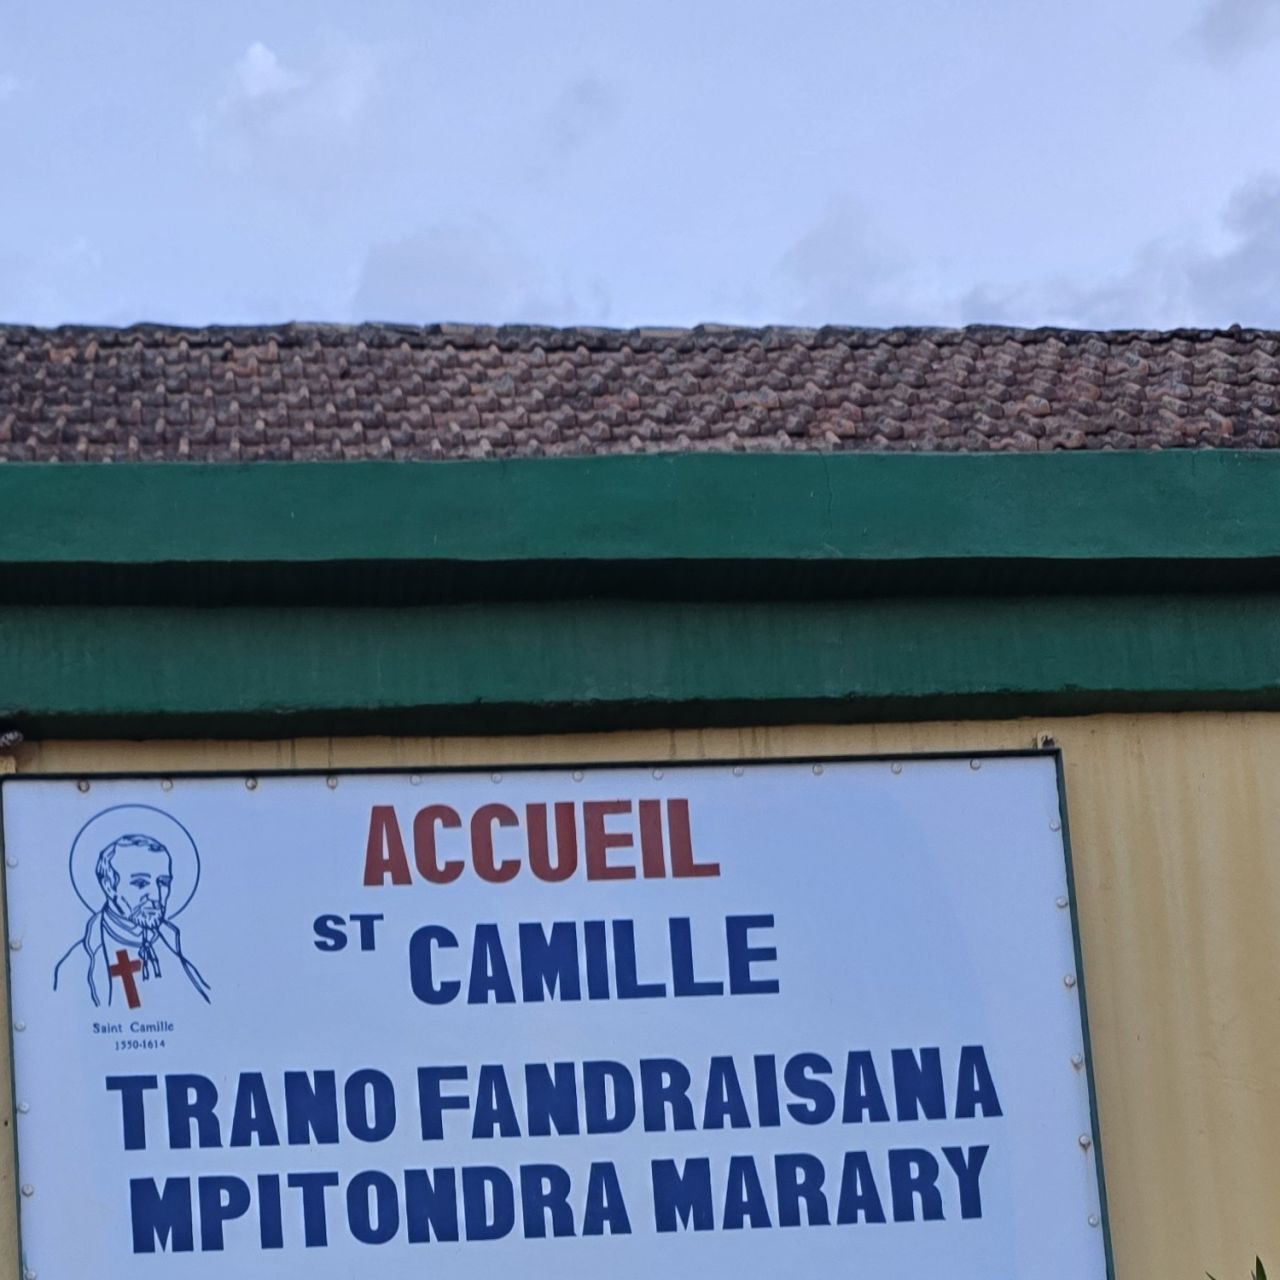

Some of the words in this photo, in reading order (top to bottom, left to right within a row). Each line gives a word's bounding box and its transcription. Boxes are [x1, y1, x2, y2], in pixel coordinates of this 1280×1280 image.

[362, 798, 722, 887] ACCUEIL
[312, 912, 385, 954] ST
[408, 912, 781, 1006] CAMILLE
[92, 1022, 123, 1035] Saint
[129, 1020, 175, 1034] Camille
[104, 1063, 397, 1152] TRANO
[416, 1043, 1005, 1143] FANDRAISANA
[128, 1160, 633, 1255] MPITONDRA
[650, 1143, 991, 1235] MARARY
